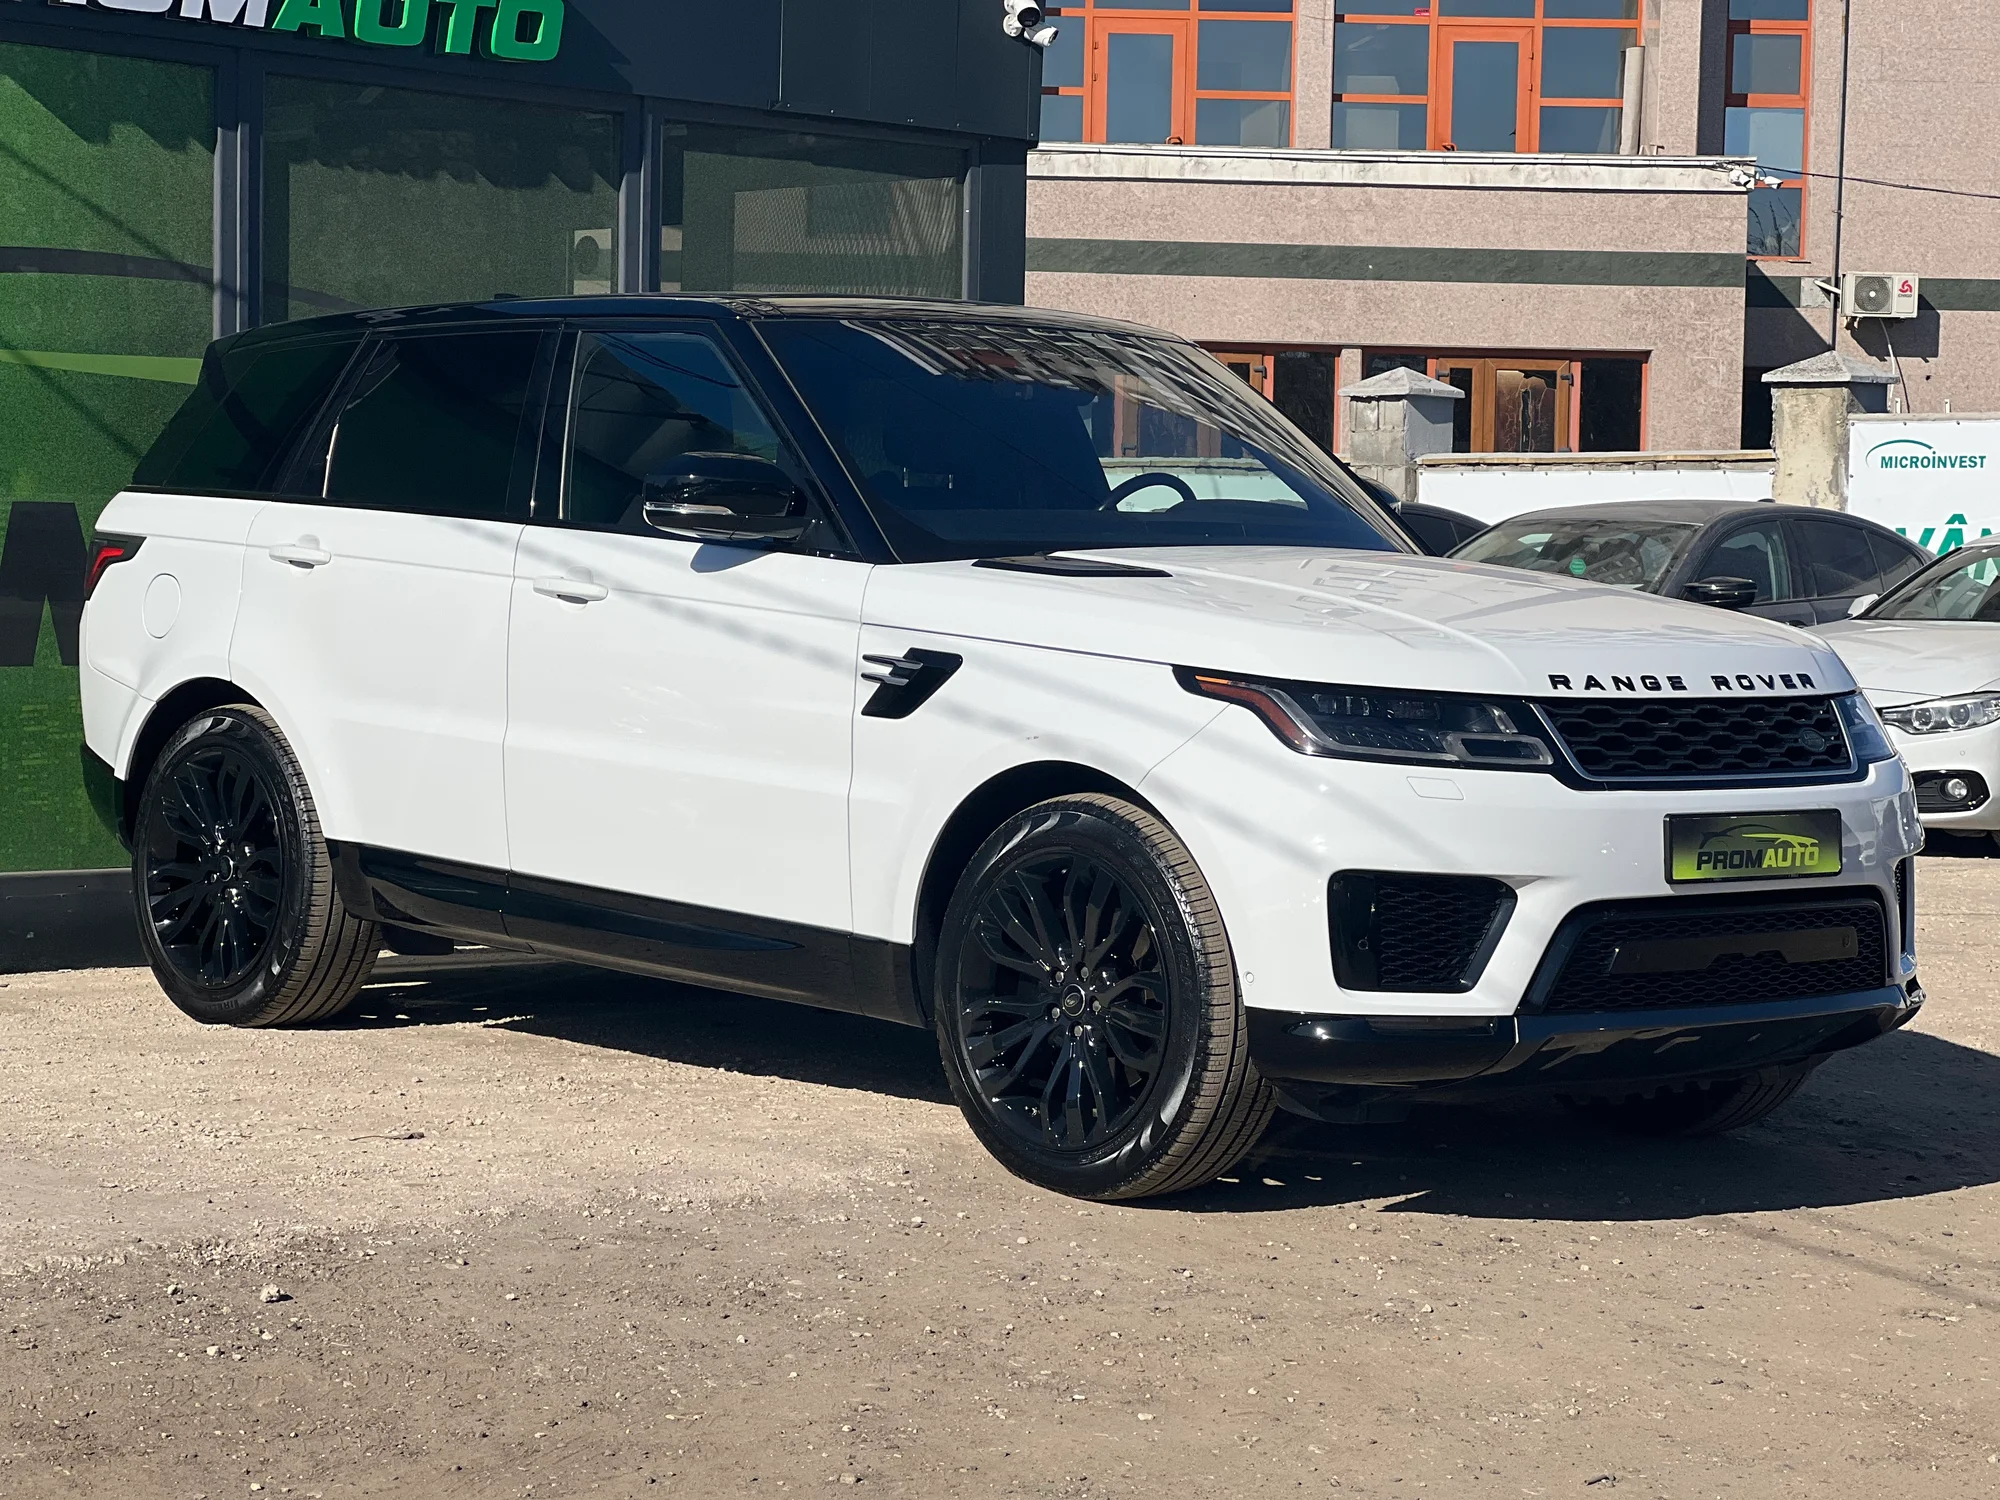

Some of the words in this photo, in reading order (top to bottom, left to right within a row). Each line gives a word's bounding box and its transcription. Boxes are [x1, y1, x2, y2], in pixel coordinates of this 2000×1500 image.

[1548, 674, 1688, 692] RANGE
[1711, 673, 1817, 690] ROVER
[1696, 847, 1820, 871] PROMAUTO
